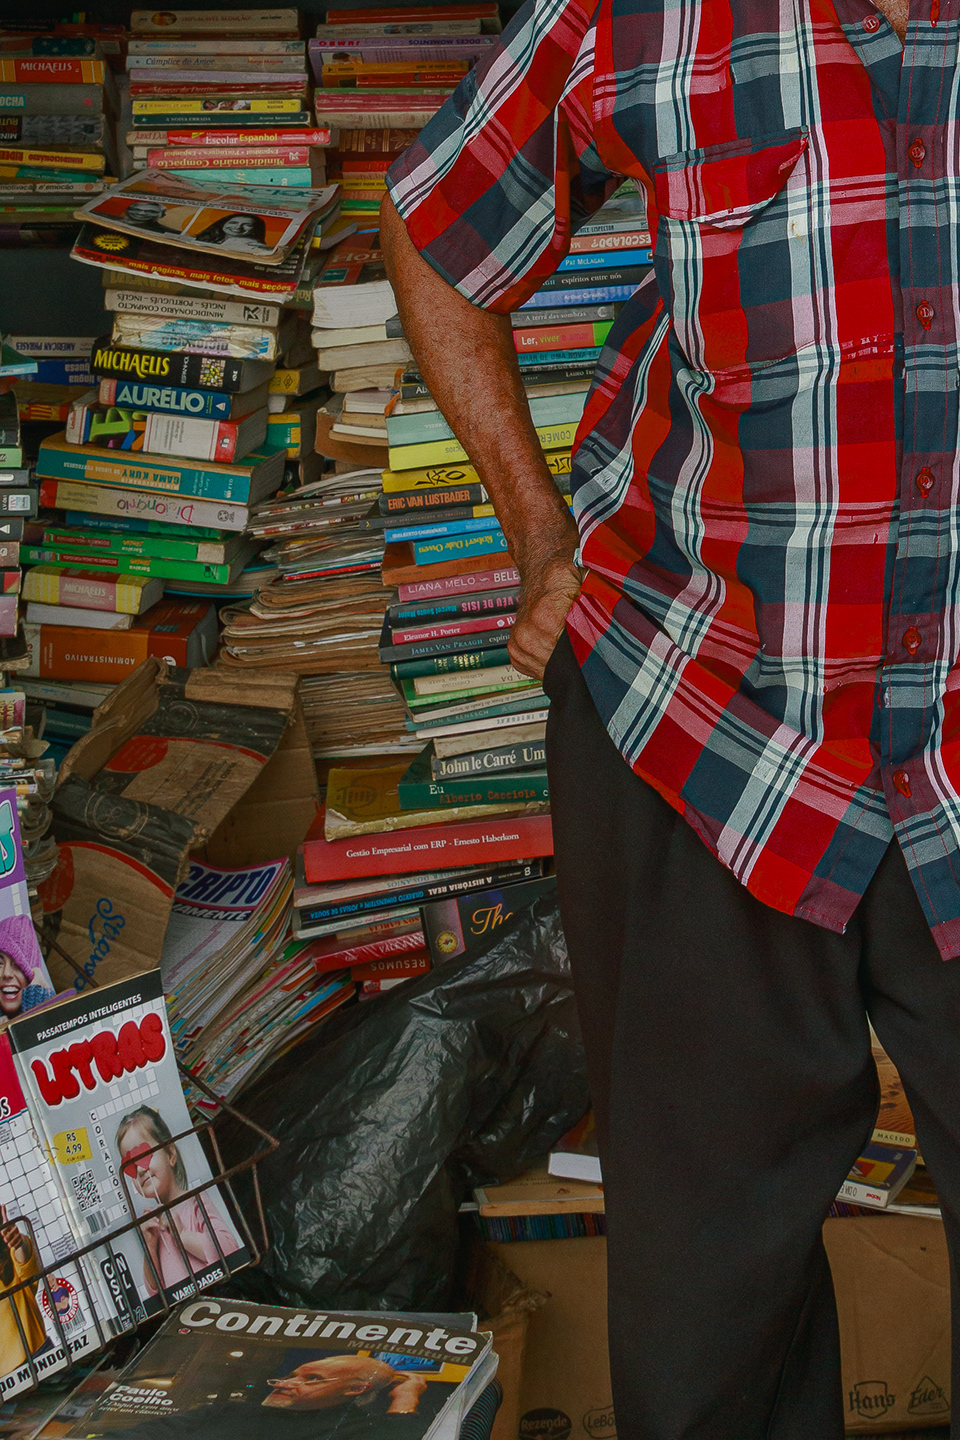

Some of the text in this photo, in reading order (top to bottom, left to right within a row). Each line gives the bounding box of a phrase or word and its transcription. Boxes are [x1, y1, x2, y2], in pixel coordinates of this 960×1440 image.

[21, 62, 72, 74] MICHAELIS
[205, 133, 277, 145] Escolar Espanhol
[117, 292, 226, 311] INGLÊS PORTUGUÊS INGLÊS
[117, 301, 224, 318] MINIDICIONÁRIO COMPACTO
[93, 349, 171, 378] MICHAELIS
[116, 385, 205, 413] AURÉLIO
[387, 489, 471, 510] ERIC VAN LUSTBADER
[408, 582, 442, 594] LIANA
[445, 577, 476, 590] MELO
[404, 626, 460, 642] Eleanor H. Porter
[64, 652, 136, 667] ADMINISTRATIVO
[439, 747, 545, 777] John le Carré Um
[429, 784, 445, 796] Eu
[439, 788, 537, 805] Alberto Cacciola
[346, 832, 520, 859] Gestão Empresarial com ERP Ernesto Haberkorn
[371, 959, 426, 973] RESUMOS
[37, 993, 142, 1042] PASSATEMPOS INTELIGENTES
[30, 1012, 166, 1106] LETRAS
[876, 1132, 912, 1144] MACEDO
[66, 1143, 82, 1156] 4,99
[178, 1301, 478, 1357] Continente
[115, 1383, 168, 1399] Paulo
[109, 1392, 174, 1408] Coelho
[849, 1390, 896, 1412] Hans
[521, 1417, 567, 1432] Rezende
